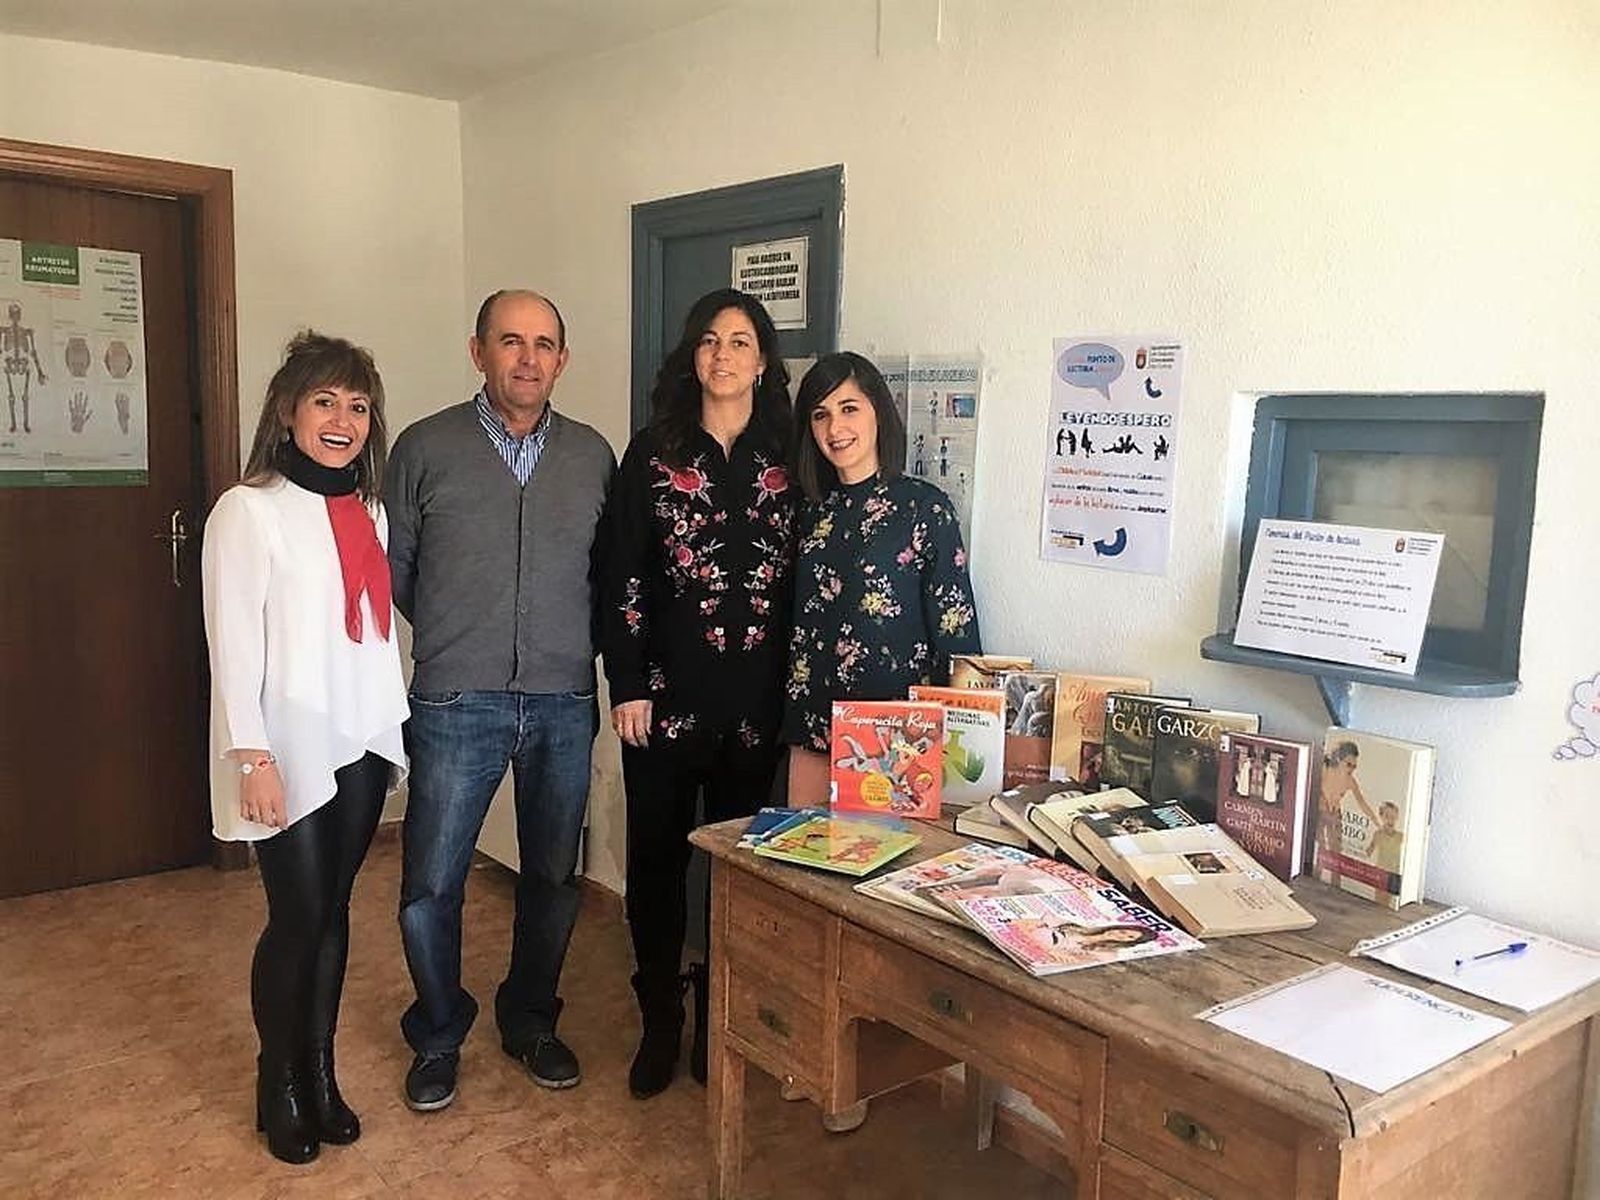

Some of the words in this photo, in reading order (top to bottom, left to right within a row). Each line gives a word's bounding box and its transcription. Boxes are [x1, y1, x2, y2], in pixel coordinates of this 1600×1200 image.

[840, 705, 903, 730] Caperucita
[907, 711, 937, 732] Roja
[1114, 700, 1156, 715] ANTO
[1112, 713, 1155, 738] GAL
[1157, 715, 1223, 741] GARZO
[1224, 800, 1264, 818] CARMEN
[1250, 813, 1287, 832] MARTIN
[1099, 888, 1174, 934] SABER
